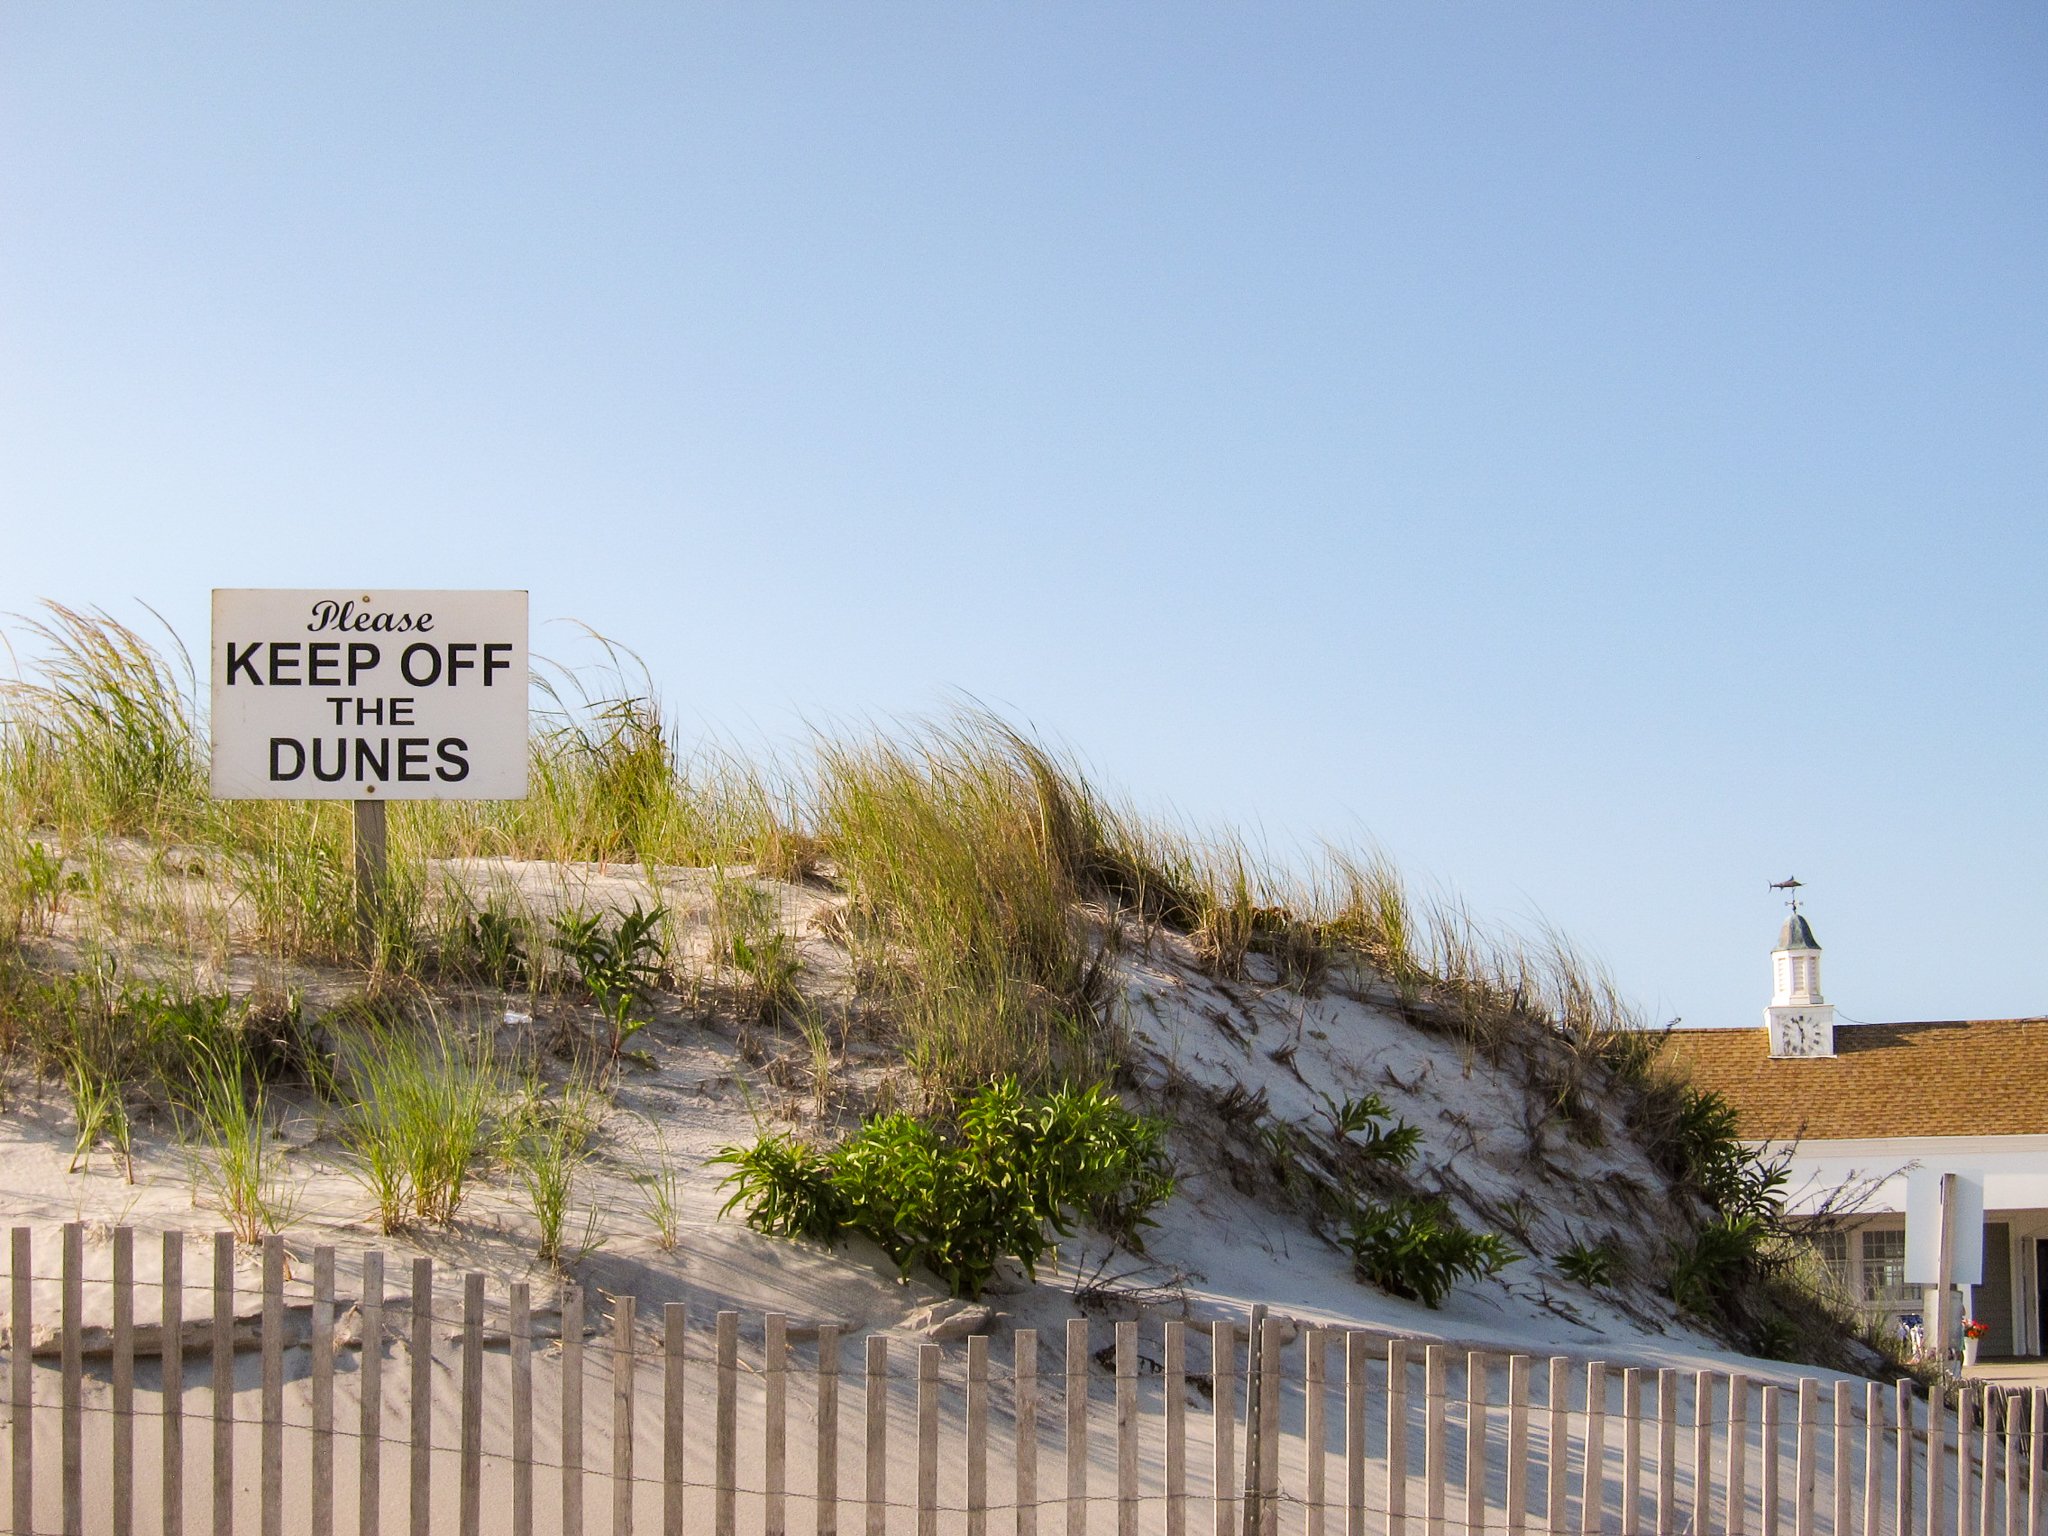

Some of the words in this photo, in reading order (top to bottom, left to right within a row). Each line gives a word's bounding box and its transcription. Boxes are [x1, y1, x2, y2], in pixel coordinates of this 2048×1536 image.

[307, 600, 434, 633] Please
[226, 642, 381, 687] KEEP
[400, 642, 513, 687] OFF
[326, 697, 415, 726] THE
[269, 737, 470, 783] DUNES
